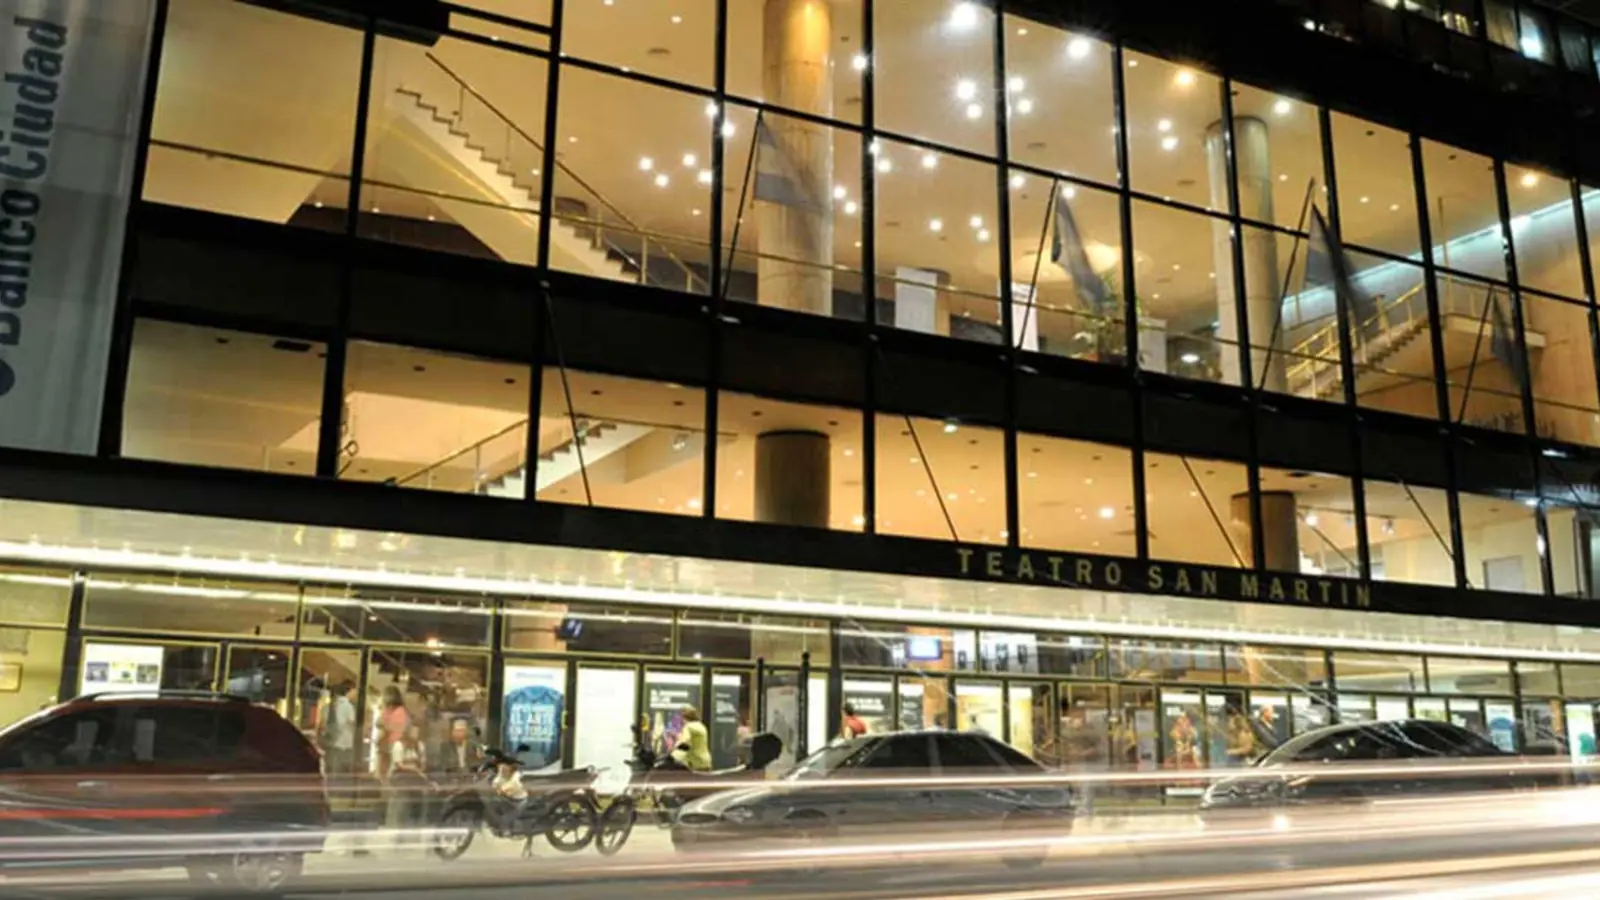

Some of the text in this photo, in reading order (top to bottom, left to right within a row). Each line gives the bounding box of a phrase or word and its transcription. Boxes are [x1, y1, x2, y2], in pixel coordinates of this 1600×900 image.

[0, 15, 68, 179] Ciudad
[957, 548, 1371, 607] TEATRO SAN MARTIN
